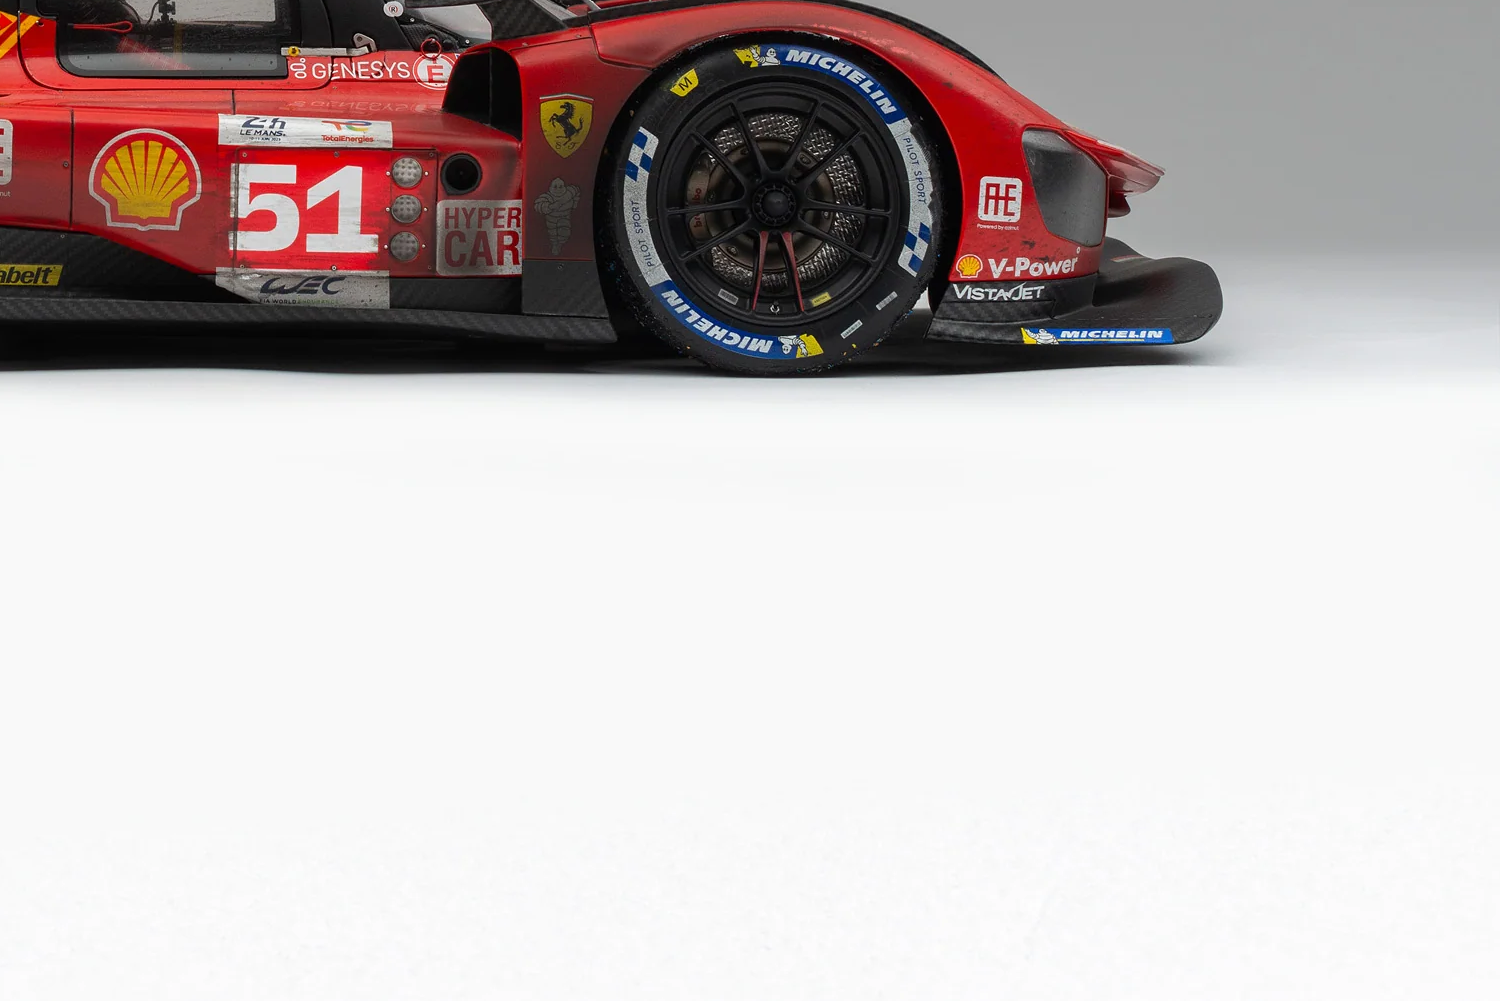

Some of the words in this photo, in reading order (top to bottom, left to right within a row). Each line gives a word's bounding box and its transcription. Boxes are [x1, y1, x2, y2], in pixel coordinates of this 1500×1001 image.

[311, 61, 411, 80] GENESYS
[678, 76, 693, 91] M
[785, 49, 898, 115] MICHELIN
[321, 135, 374, 144] TotalEnergies
[902, 136, 920, 167] PILOT
[913, 169, 927, 205] SPORT
[228, 163, 379, 253] 51
[444, 206, 522, 230] HYPER
[631, 200, 644, 234] SPORT
[444, 230, 521, 268] CAR
[638, 236, 655, 268] PILOT
[988, 256, 1078, 279] V-Power
[259, 275, 347, 295] WEC
[661, 288, 774, 354] MICHELIN
[1060, 330, 1164, 339] MICHELIN
